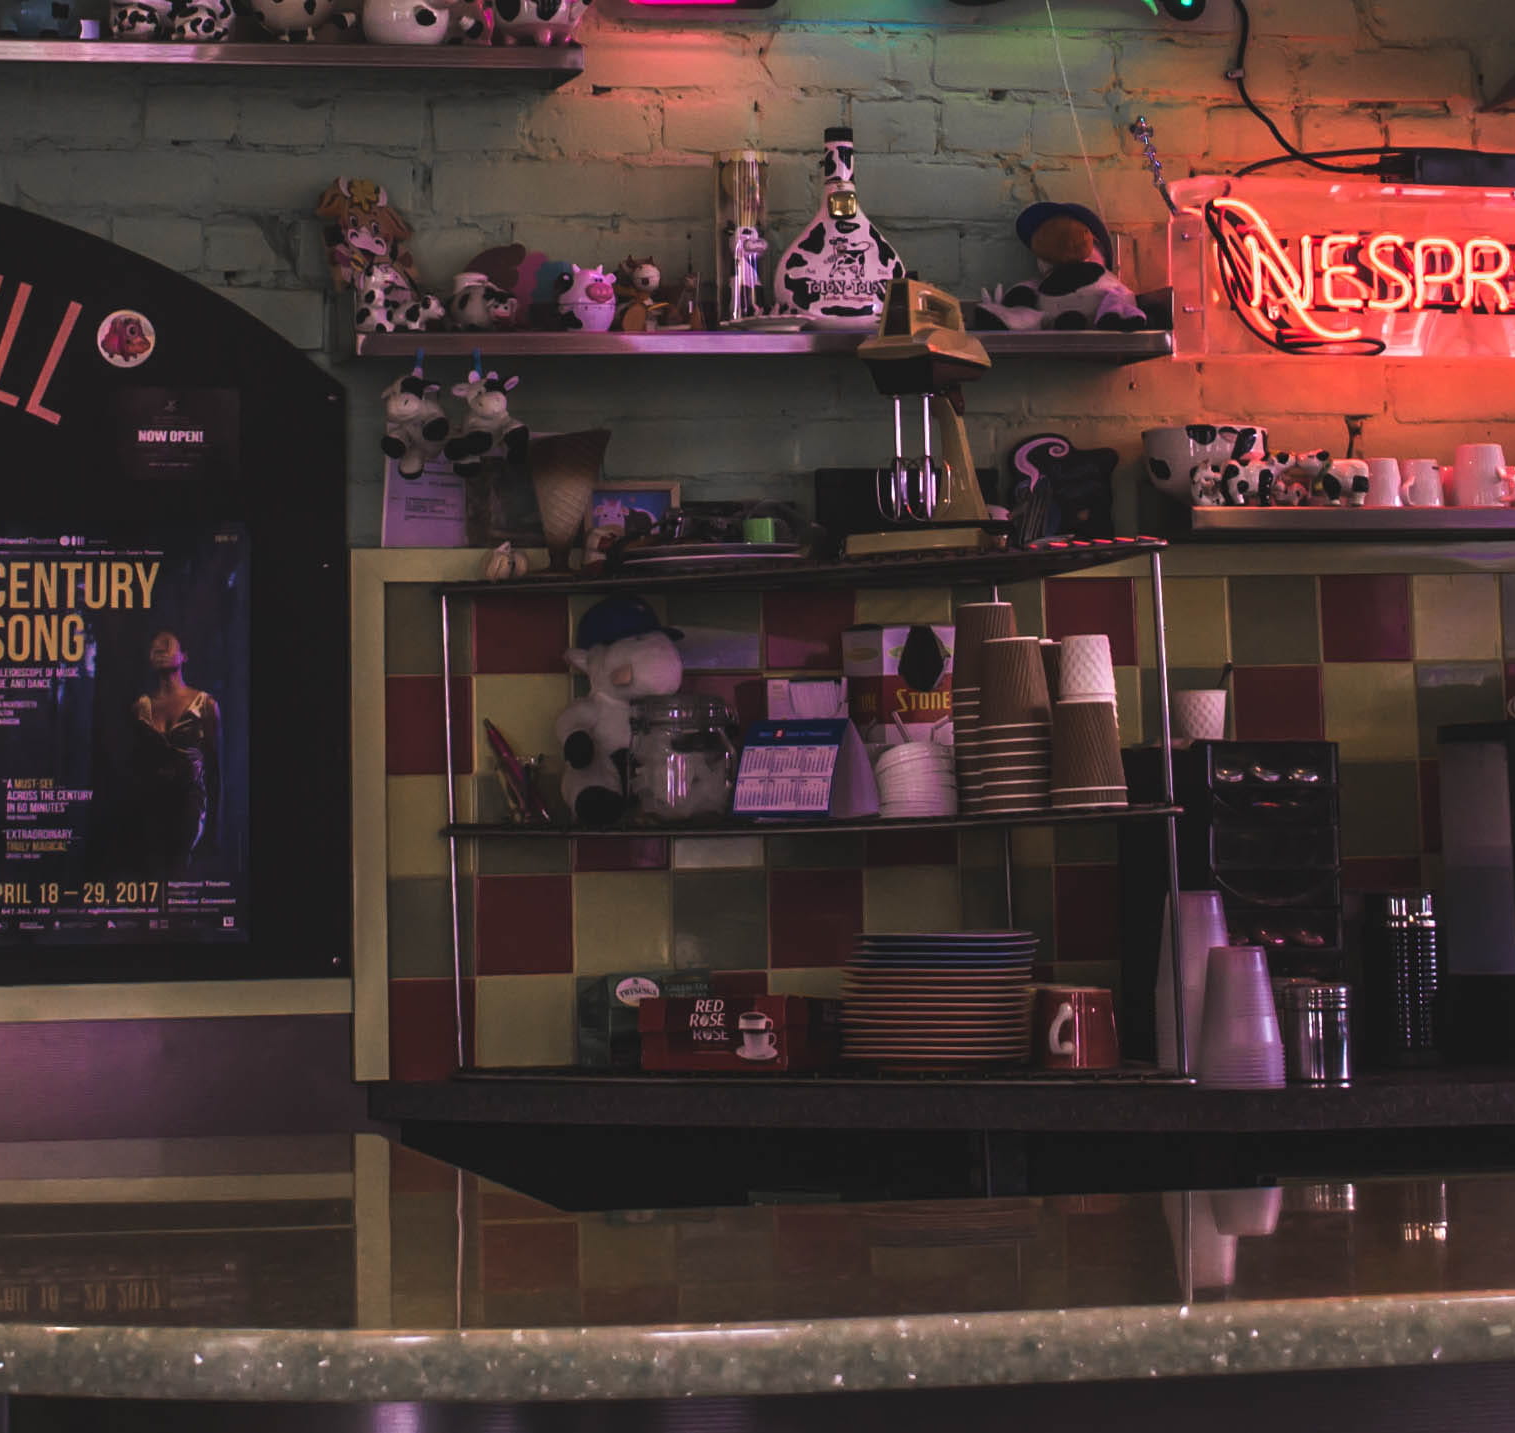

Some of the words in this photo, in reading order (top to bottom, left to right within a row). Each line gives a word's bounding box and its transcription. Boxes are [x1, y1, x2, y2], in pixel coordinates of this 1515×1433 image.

[137, 429, 167, 443] NOW
[169, 429, 205, 443] OPEN!
[56, 790, 94, 801] CENTURY
[40, 882, 60, 904] 18
[83, 882, 111, 907] 29,
[116, 881, 160, 904] 2017
[695, 998, 725, 1013] RED
[689, 1012, 726, 1029] ROSE
